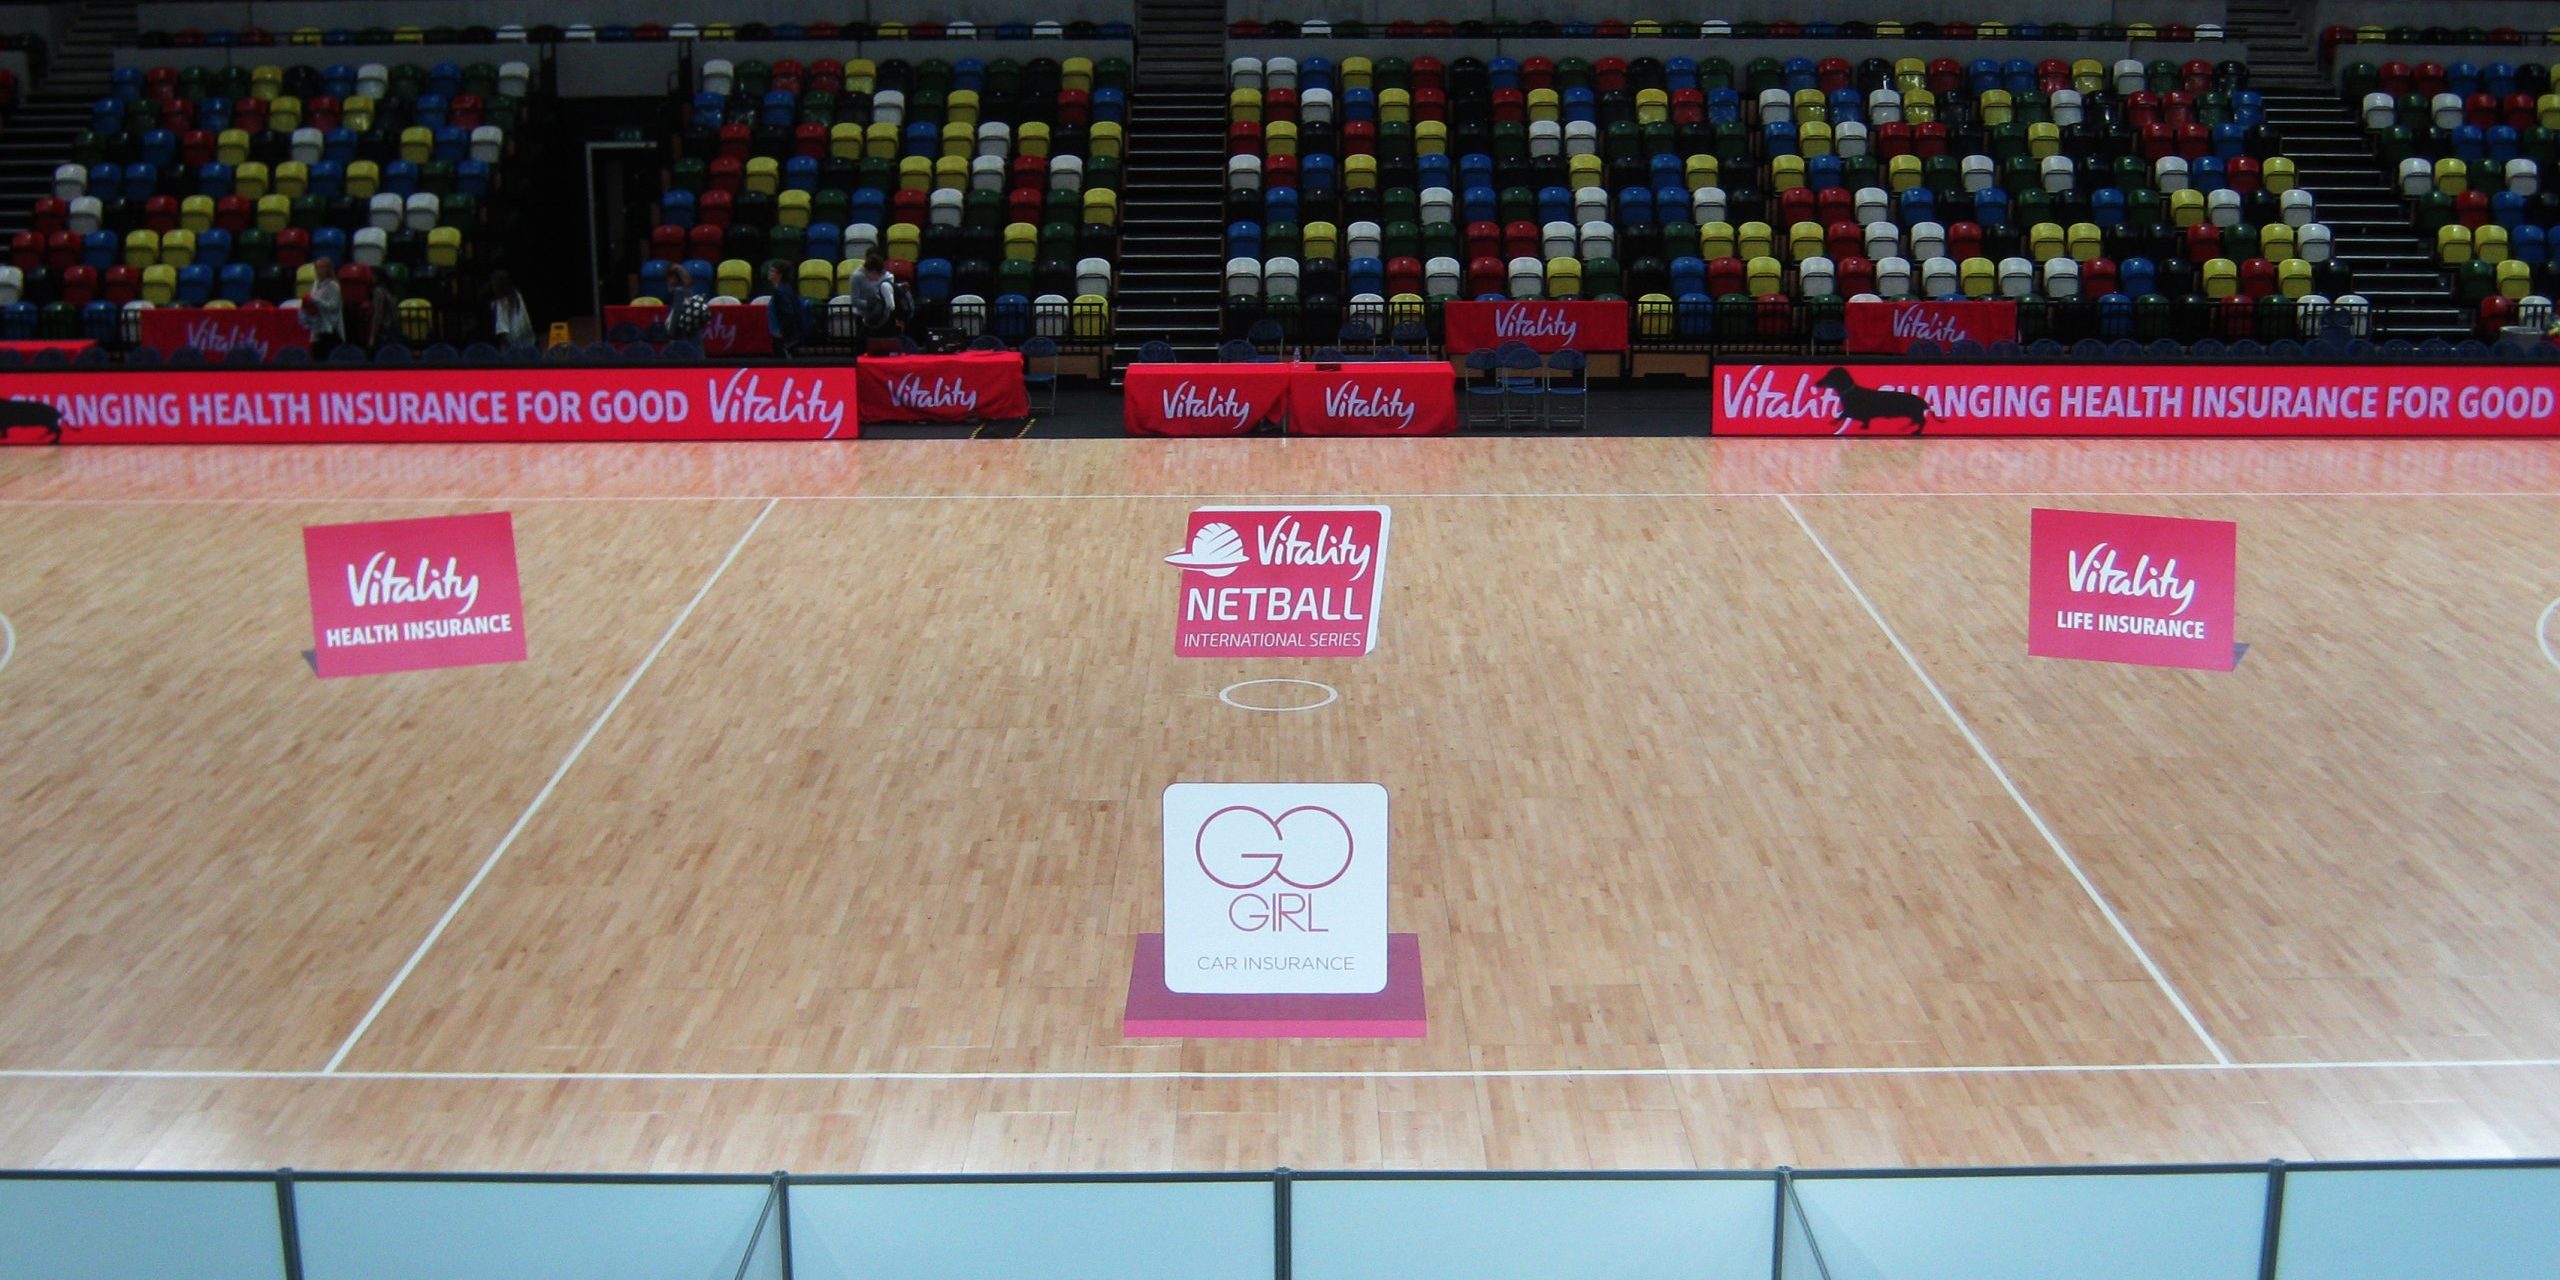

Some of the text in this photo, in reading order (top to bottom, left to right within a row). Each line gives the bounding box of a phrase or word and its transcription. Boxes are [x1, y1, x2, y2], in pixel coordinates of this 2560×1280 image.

[1495, 302, 1577, 346] Vitality
[1893, 303, 1966, 342] Vitality
[9, 389, 688, 427] ANGING HEALTH INSURANCE FOR GOOD
[708, 367, 844, 439] Vitality
[888, 372, 977, 411] Vitality
[1163, 381, 1249, 430] Vitality
[1325, 380, 1415, 429] Vitality
[1877, 385, 2554, 419] ANGING HEALTH INSURANCE FOR GOOD
[1258, 515, 1371, 581] Vitality
[347, 551, 479, 615] Vitality
[2068, 542, 2195, 616] Vitality
[1187, 587, 1363, 621] NETBALL
[326, 614, 512, 647] HEALTH INSURANCE
[1184, 632, 1361, 647] INTERNATIONAL SERIES
[2057, 610, 2205, 639] LIFE INSURANCE
[1195, 805, 1354, 890] GO
[1228, 893, 1329, 932] GIRL
[1197, 956, 1355, 970] CAR INSURANCE
